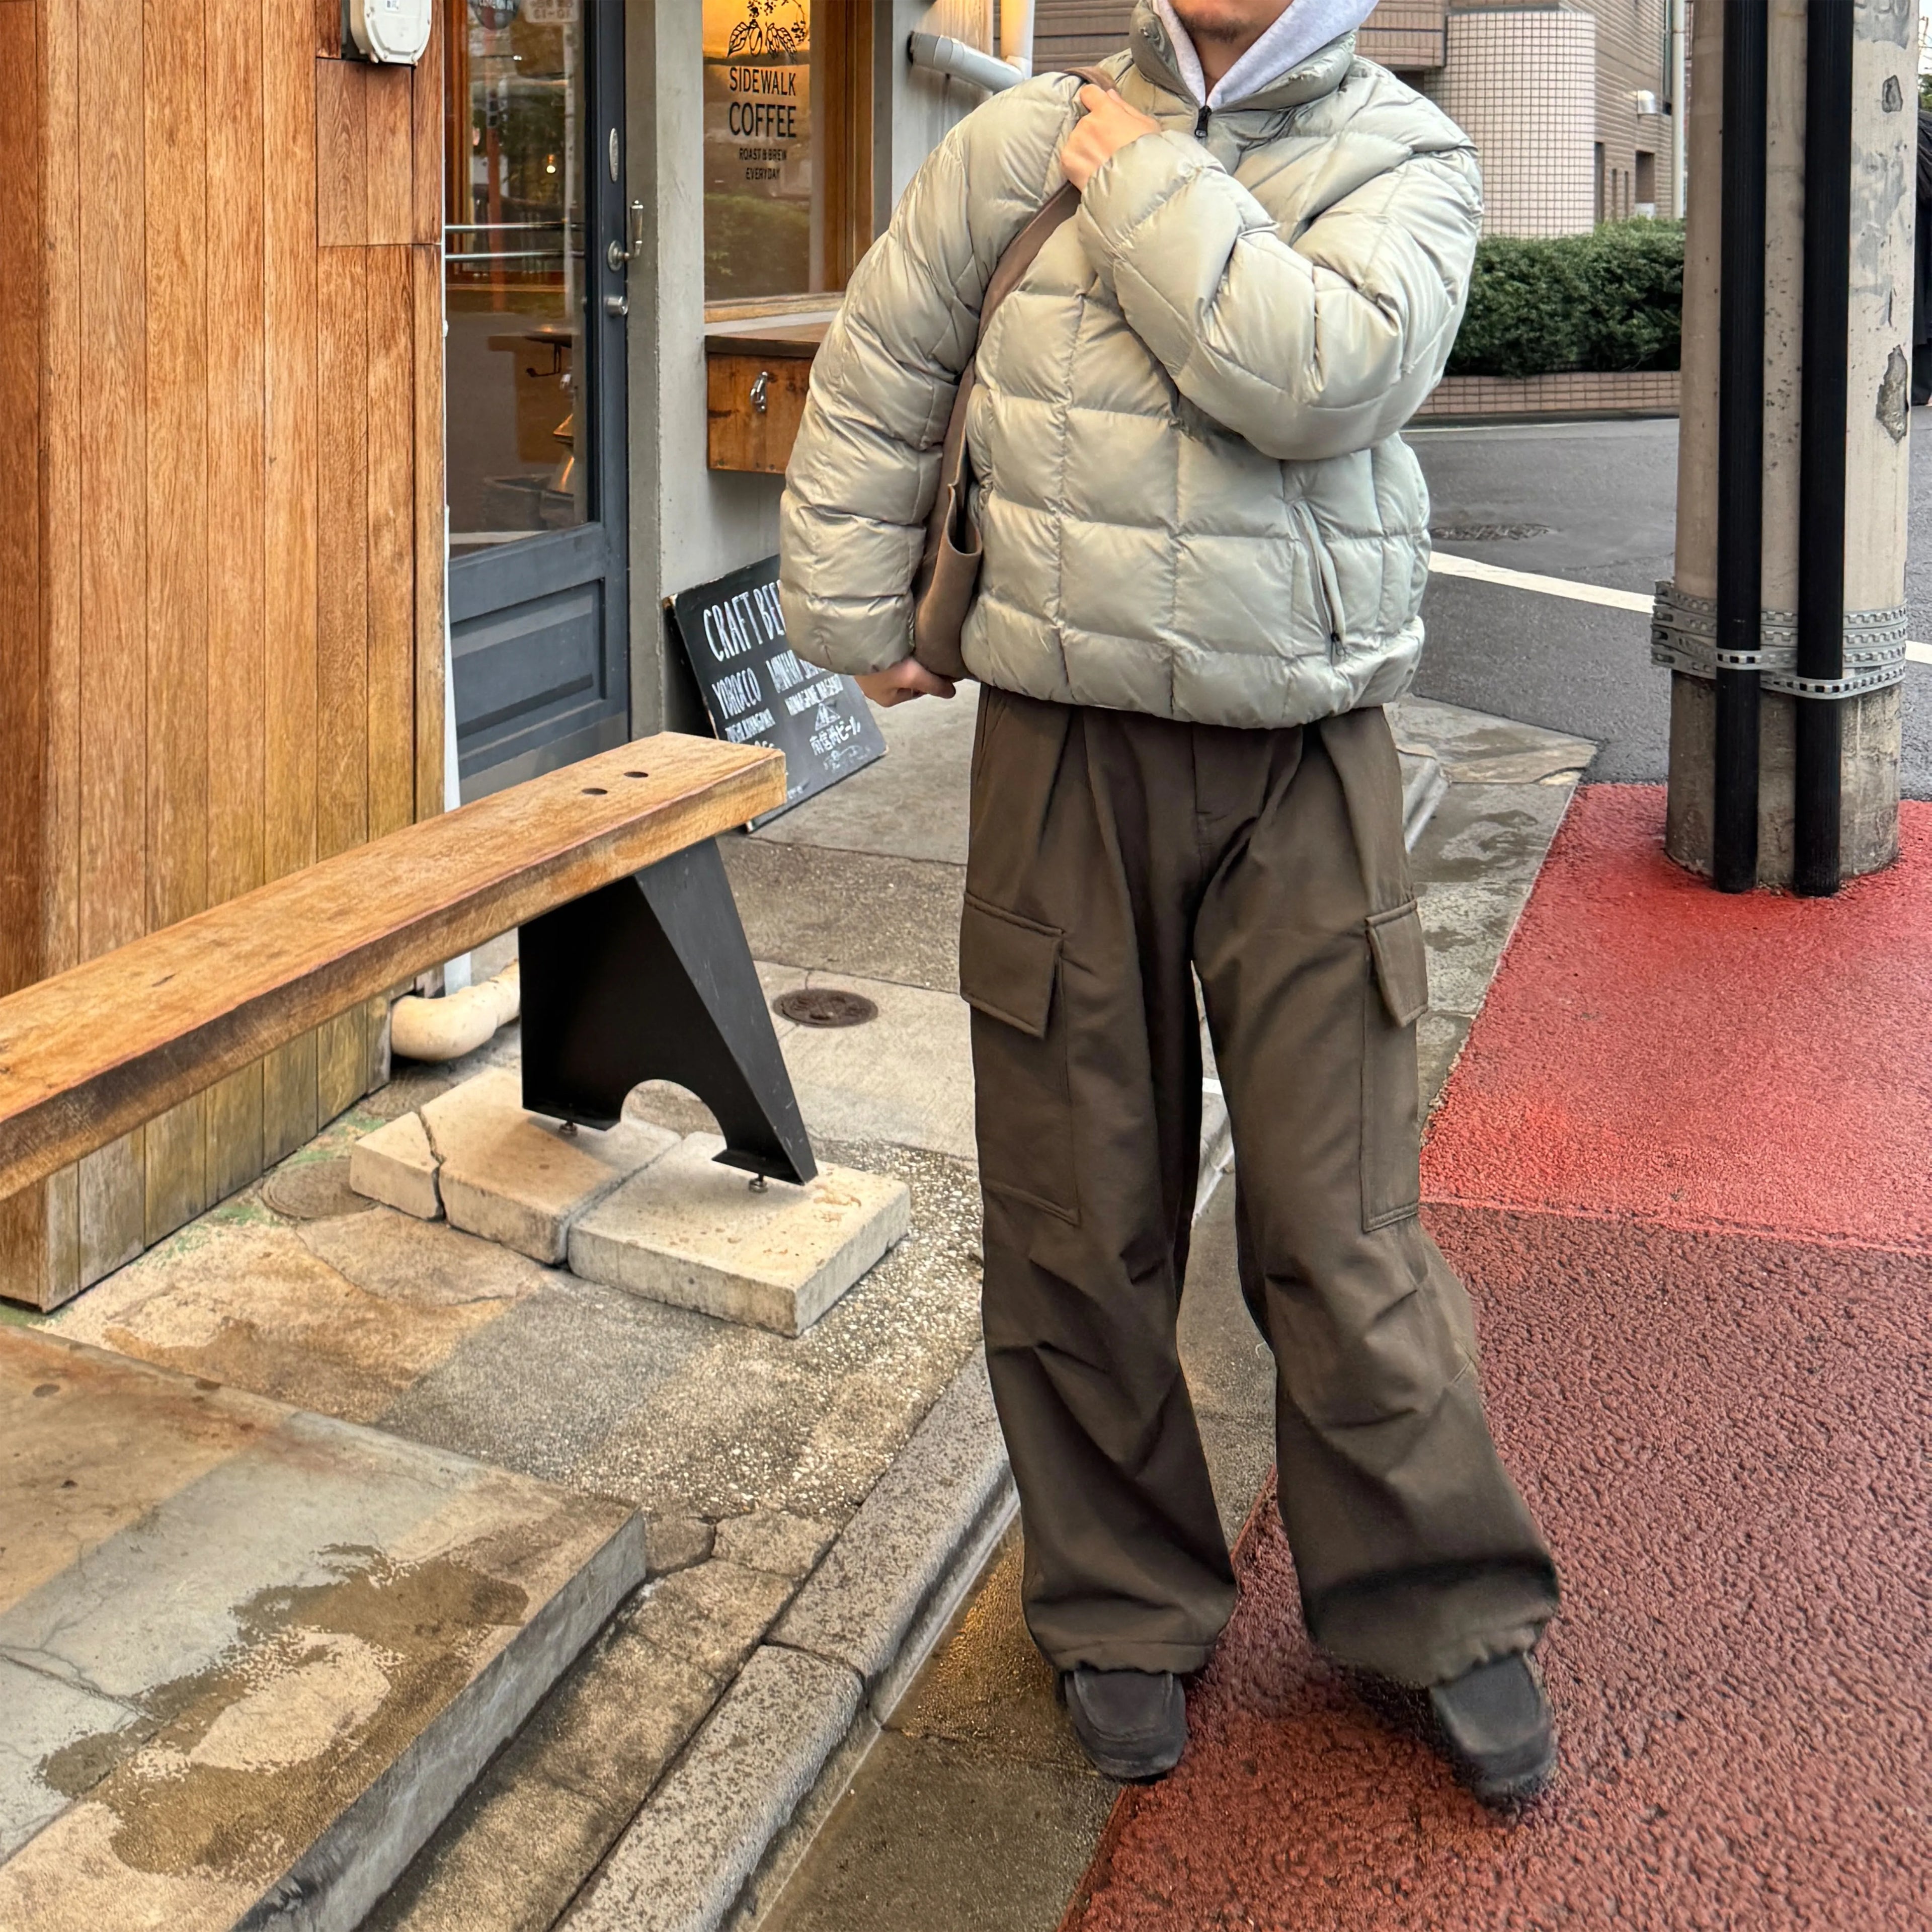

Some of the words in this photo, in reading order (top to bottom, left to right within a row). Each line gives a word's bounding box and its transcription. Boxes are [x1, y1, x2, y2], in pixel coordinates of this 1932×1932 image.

[730, 67, 796, 96] SIDEWALK
[730, 102, 796, 137] COFFEE
[746, 168, 780, 180] EVERYDAY
[703, 592, 763, 662] CRAFT
[753, 579, 786, 640] BEE
